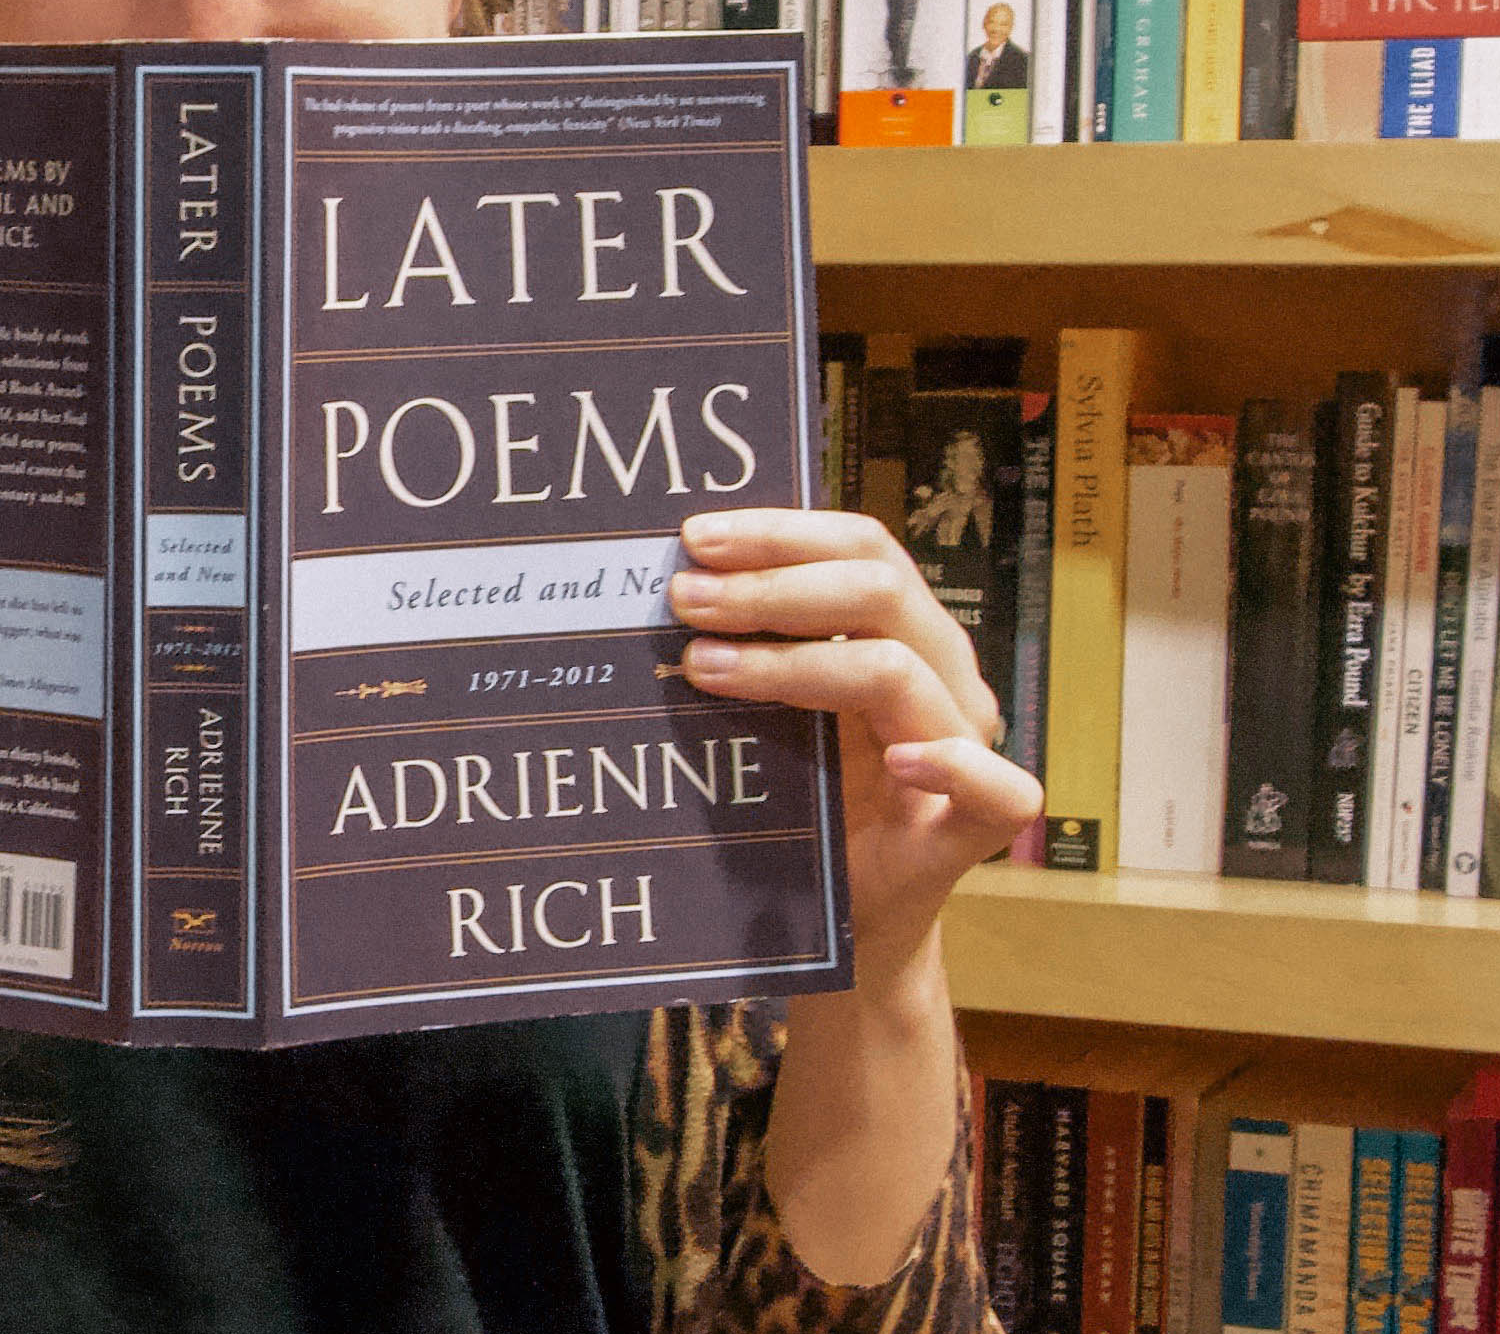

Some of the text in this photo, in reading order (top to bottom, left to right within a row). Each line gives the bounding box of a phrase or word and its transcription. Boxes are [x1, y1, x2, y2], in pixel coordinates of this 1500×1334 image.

[1409, 45, 1436, 96] ILIAD
[24, 194, 74, 216] AND
[43, 161, 72, 184] BY
[320, 186, 749, 313] LATER
[177, 102, 219, 486] LATER POEMS
[320, 383, 758, 514] POEMS
[1069, 373, 1104, 551] Sylvia Plath
[153, 566, 236, 583] and New
[158, 537, 233, 557] Selected
[386, 567, 664, 615] Selected and Ne
[164, 746, 191, 816] RICH
[197, 707, 225, 855] ADRIENNE
[329, 735, 771, 838] ADRIENNE
[445, 875, 659, 960] RICH
[1291, 1163, 1323, 1314] CHIMAMANDA
